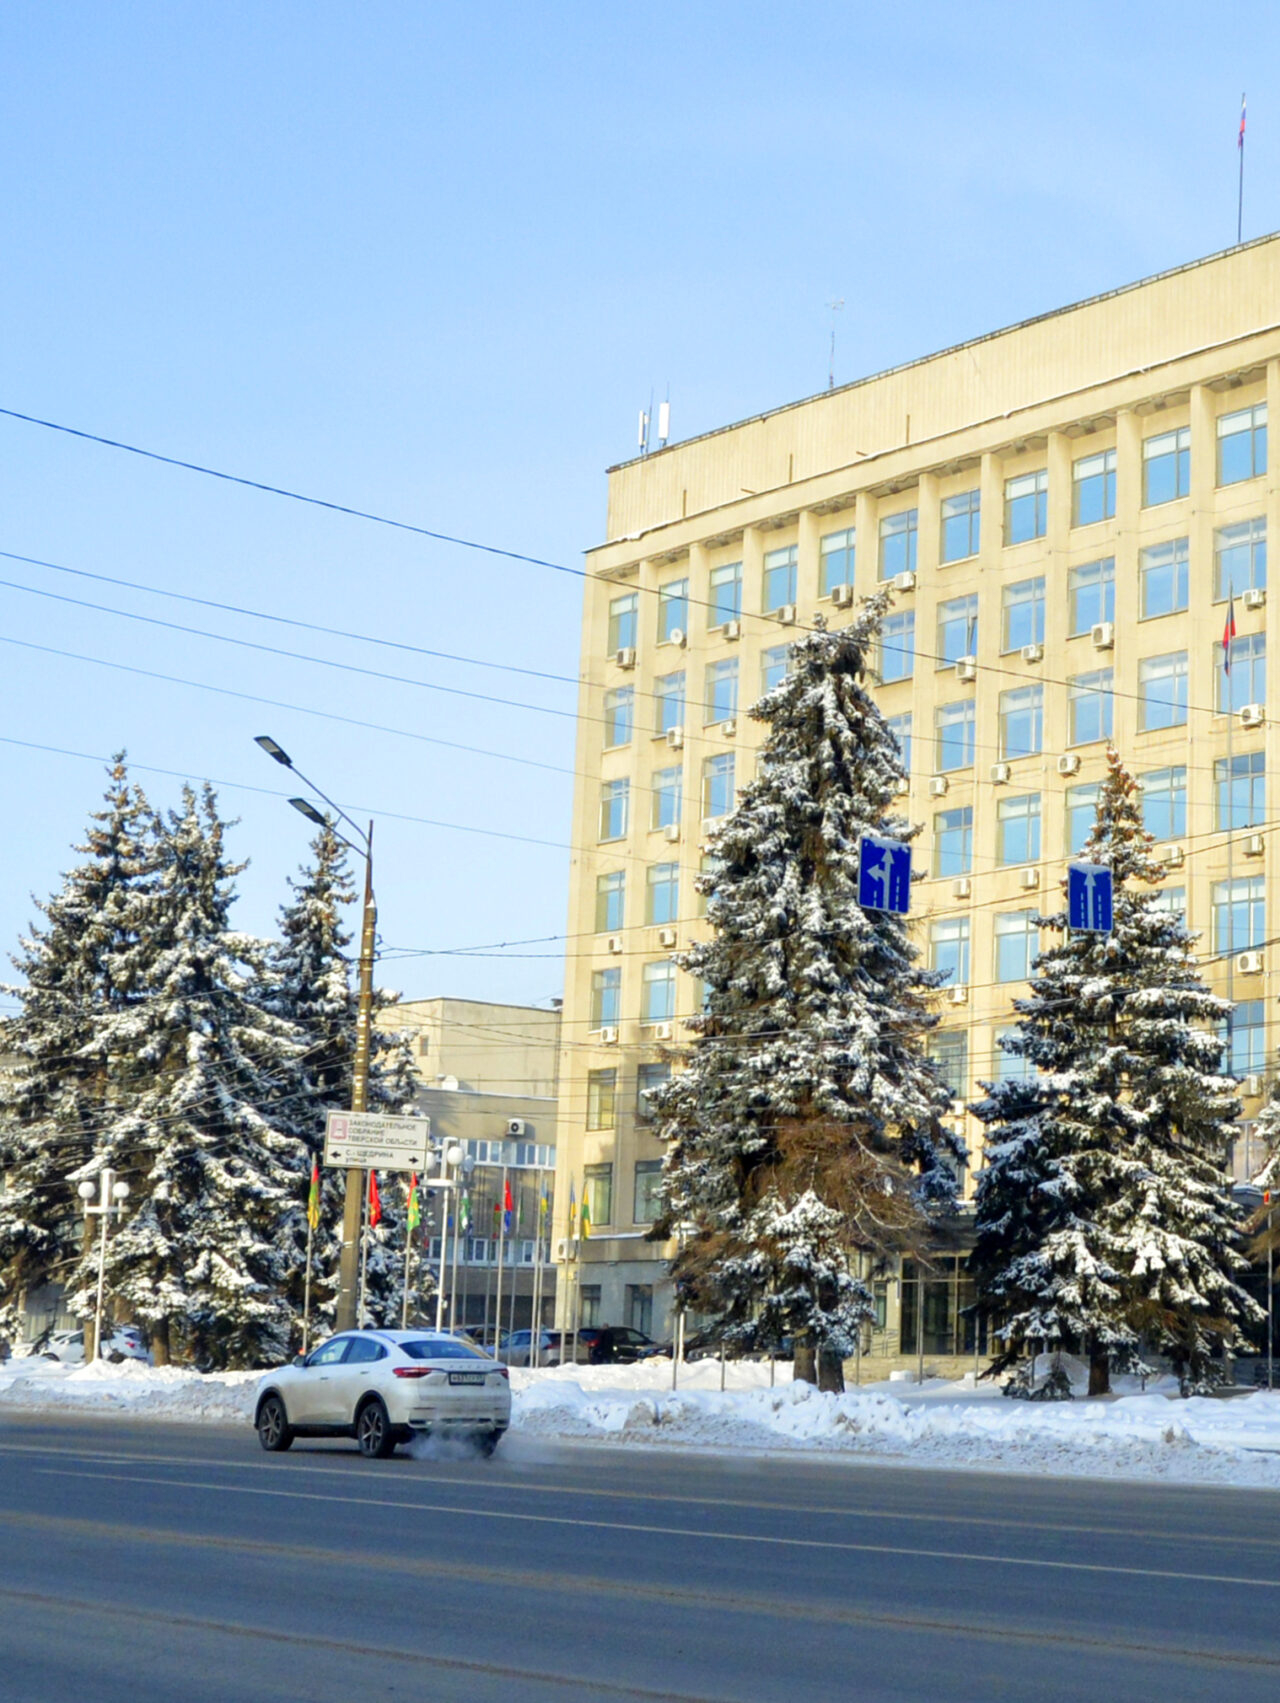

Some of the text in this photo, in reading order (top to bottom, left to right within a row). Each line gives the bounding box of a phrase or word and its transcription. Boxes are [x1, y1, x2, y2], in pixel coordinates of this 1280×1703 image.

[349, 1120, 416, 1130] ЗАКОНОДАТЕЛЬНОЕ
[348, 1127, 385, 1135] СОБРАНИЕ
[348, 1135, 384, 1143] ТВЕРСКОЙ
